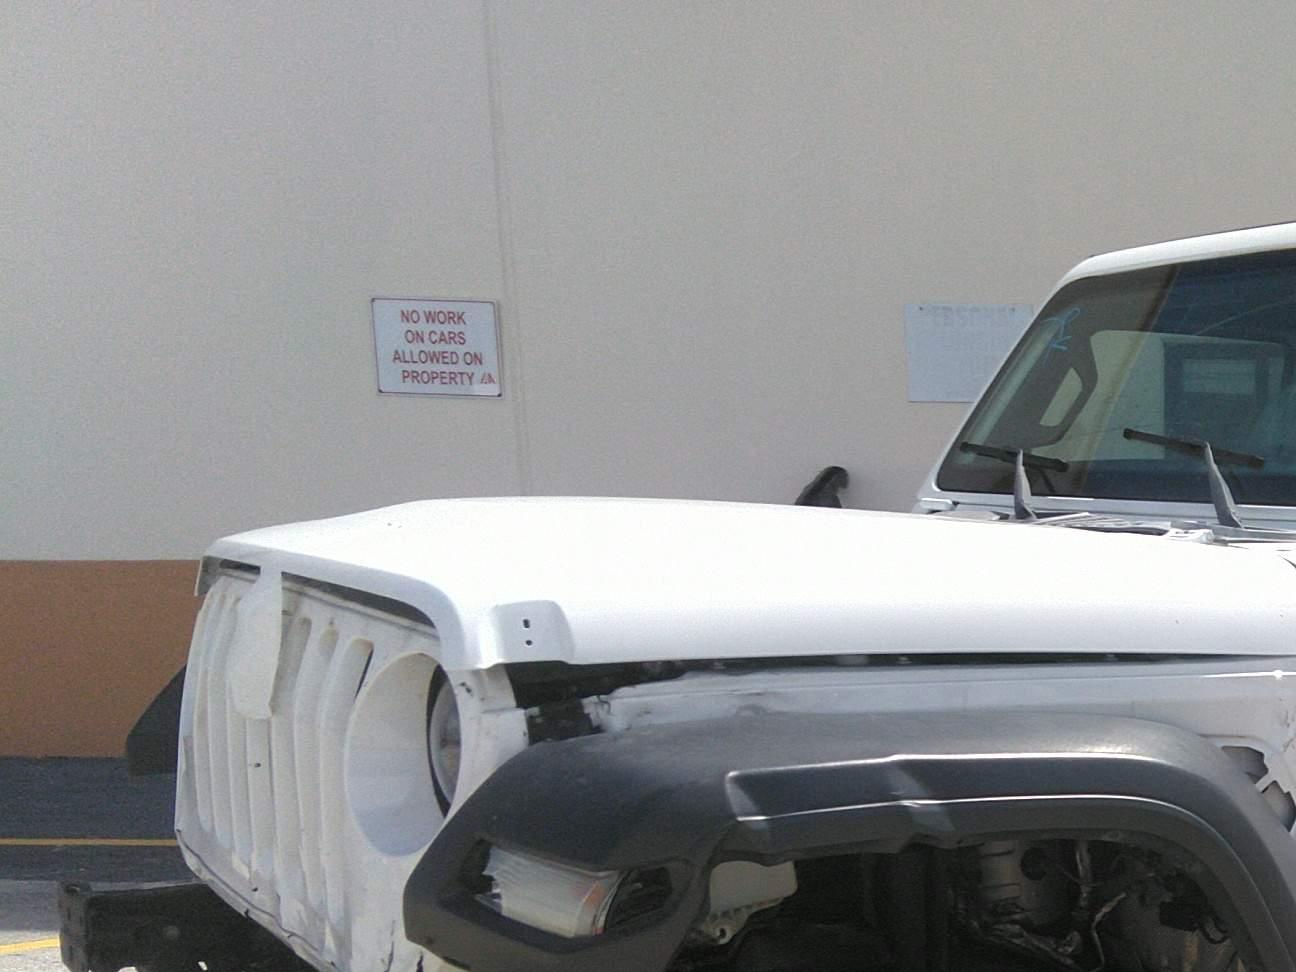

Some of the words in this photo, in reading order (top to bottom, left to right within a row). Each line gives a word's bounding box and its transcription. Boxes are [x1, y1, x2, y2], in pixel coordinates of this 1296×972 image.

[400, 309, 420, 324] NO
[423, 310, 467, 325] WORK
[404, 329, 425, 344] ON
[428, 330, 466, 345] CARS
[392, 349, 460, 365] ALLOWED
[463, 351, 483, 366] ON
[401, 369, 475, 385] PROPERTY
